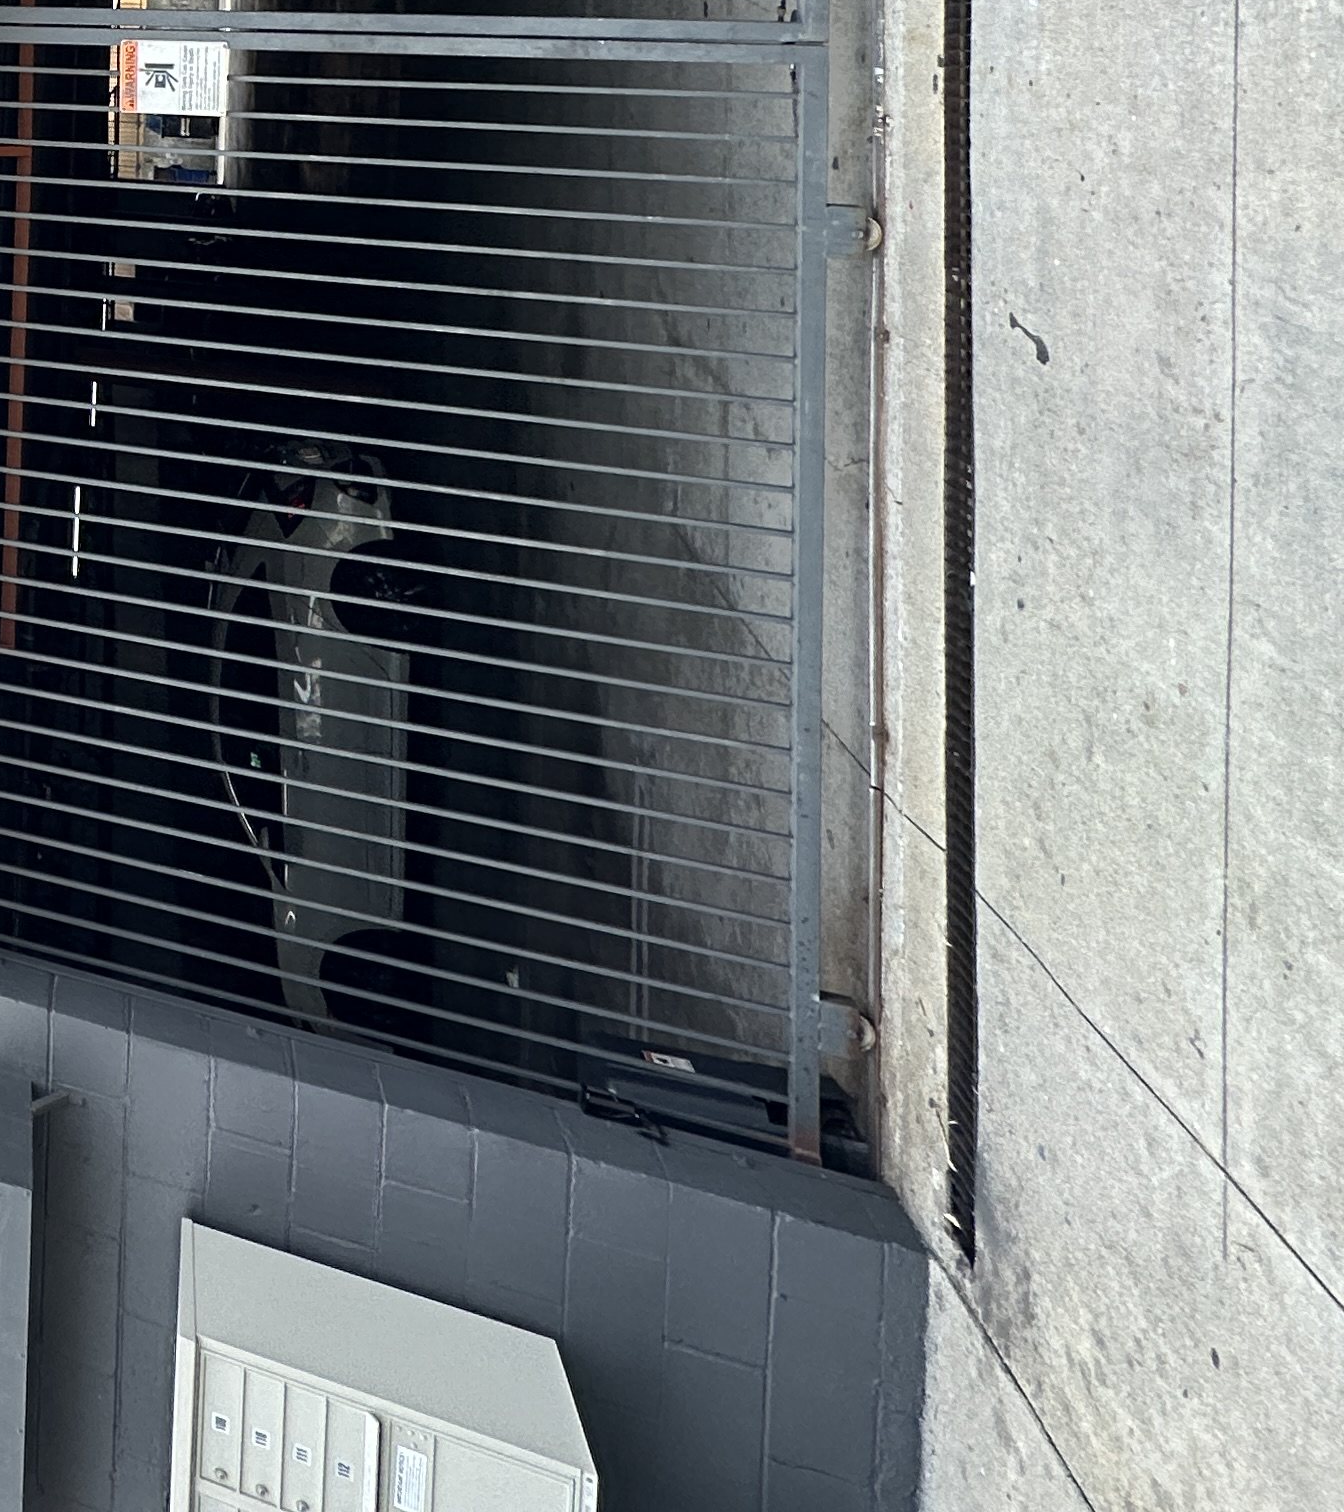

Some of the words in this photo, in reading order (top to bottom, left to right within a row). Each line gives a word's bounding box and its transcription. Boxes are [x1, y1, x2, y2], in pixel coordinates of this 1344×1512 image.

[124, 45, 136, 100] WARNING
[296, 1447, 308, 1462] 111
[337, 1462, 350, 1478] 112
